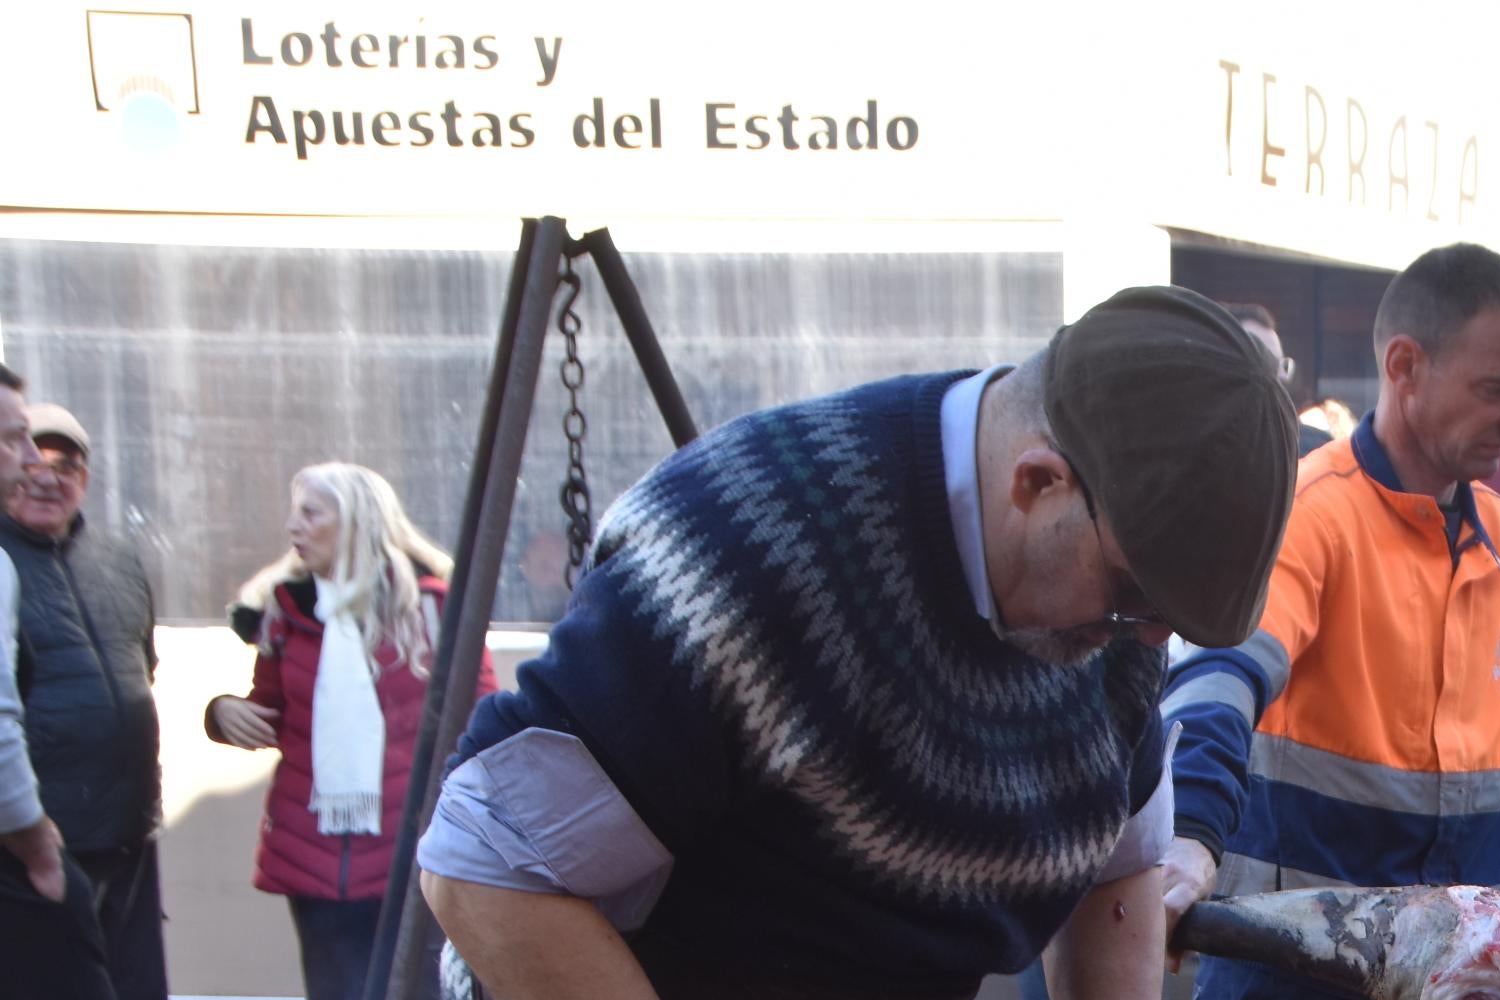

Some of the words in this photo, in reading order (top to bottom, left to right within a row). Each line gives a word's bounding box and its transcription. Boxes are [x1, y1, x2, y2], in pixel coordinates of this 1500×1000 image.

[240, 17, 499, 70] Loterías
[534, 35, 563, 86] y
[245, 95, 536, 160] Apuestas
[572, 96, 663, 150] del
[705, 99, 919, 152] Estado
[1218, 59, 1478, 225] TERRAZA
